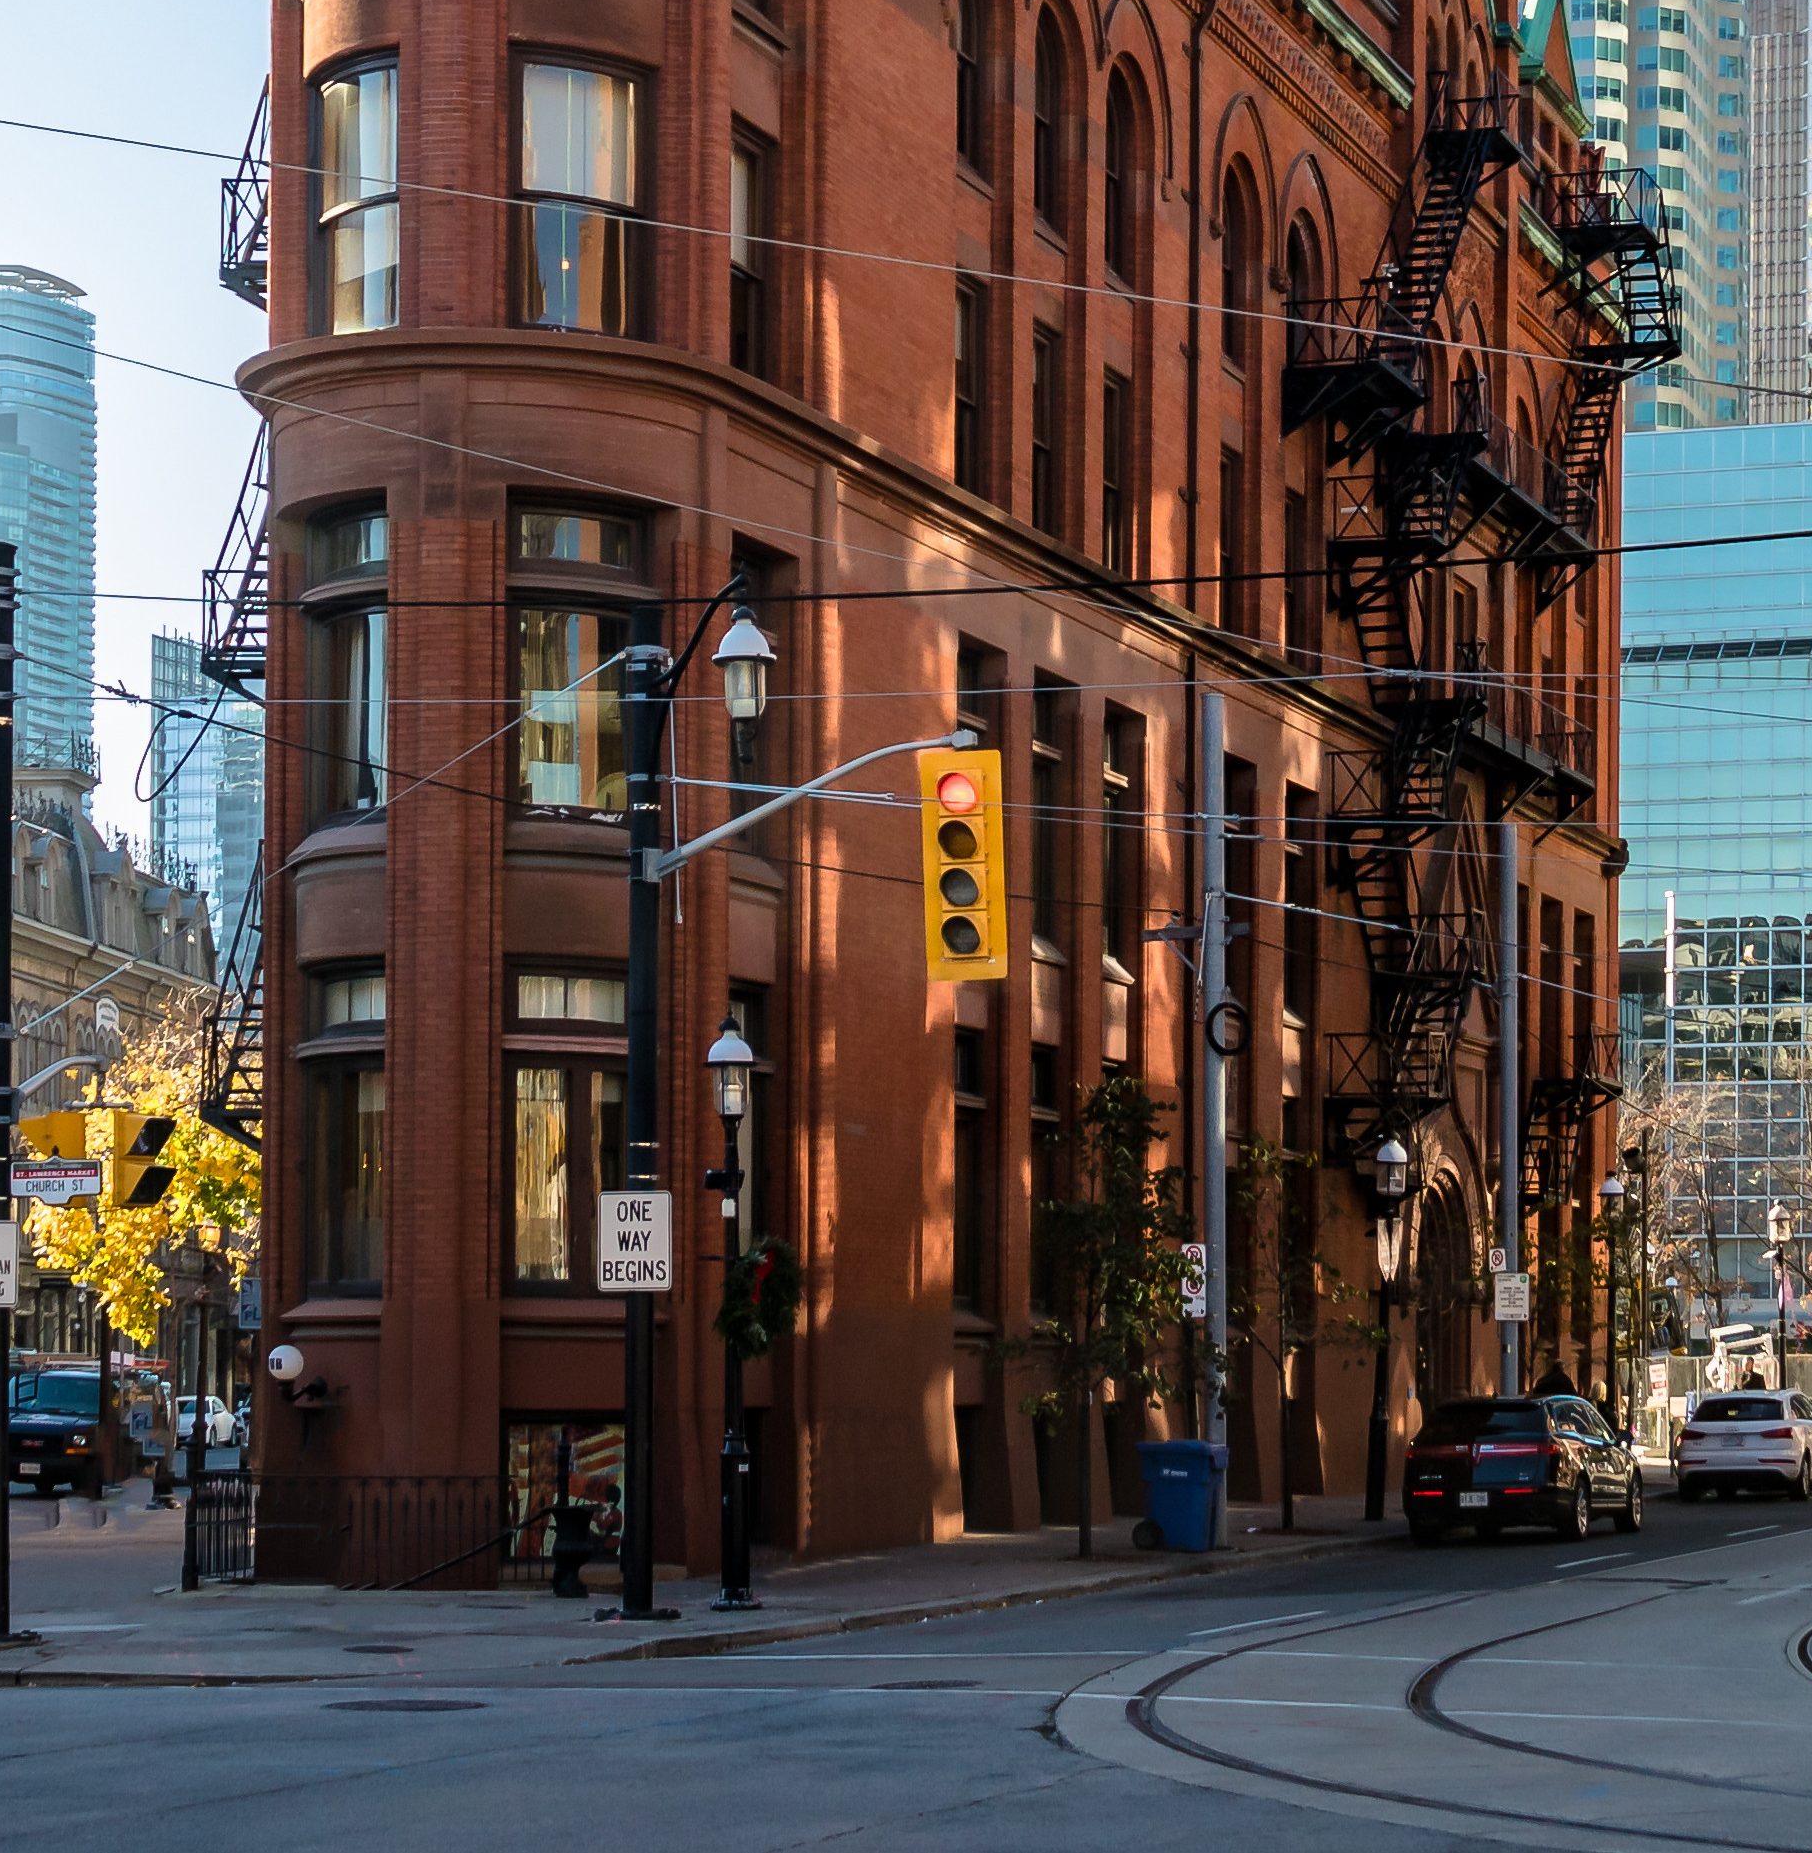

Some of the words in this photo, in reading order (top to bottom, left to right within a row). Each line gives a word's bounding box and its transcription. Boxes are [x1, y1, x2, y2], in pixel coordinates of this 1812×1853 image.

[26, 1180, 64, 1192] CHURCH
[617, 1201, 652, 1222] ONE
[618, 1231, 651, 1251] WAY
[603, 1260, 666, 1281] BEGINS
